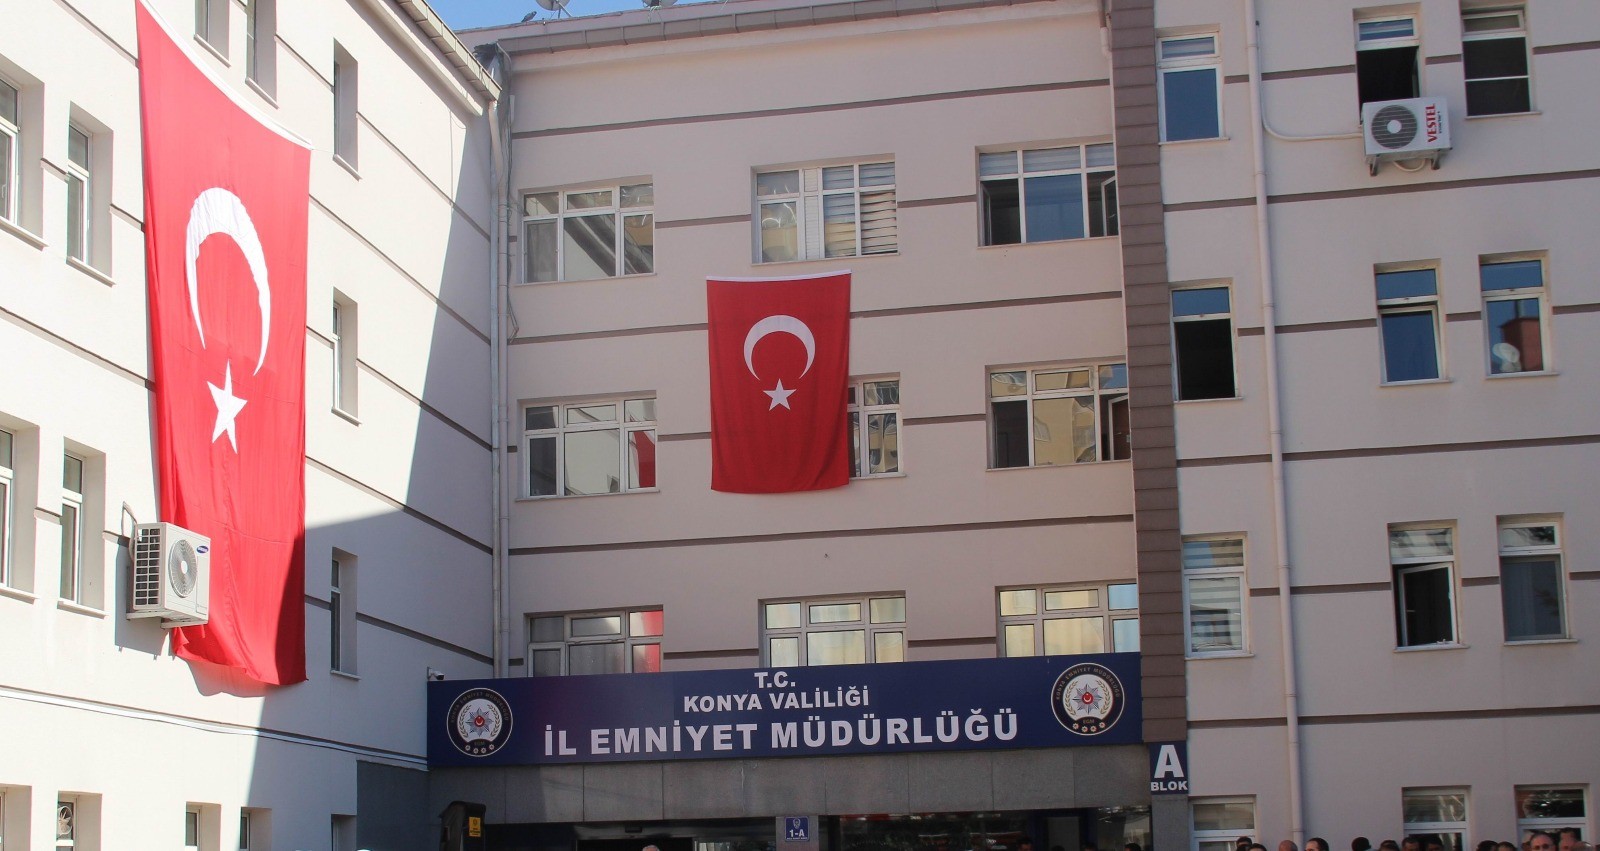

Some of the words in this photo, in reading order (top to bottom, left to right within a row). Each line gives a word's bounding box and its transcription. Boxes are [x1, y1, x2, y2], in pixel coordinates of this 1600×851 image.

[1425, 103, 1438, 143] VESTEL
[753, 671, 796, 689] T.C.
[683, 693, 763, 713] KONYA
[768, 685, 870, 710] VALİLİĞİ
[545, 724, 577, 756] İL
[590, 719, 758, 755] EMNİYET
[771, 708, 1018, 749] MÜDÜRLÜĞÜ
[1154, 744, 1185, 779] A
[1150, 780, 1189, 792] BLOK
[789, 828, 805, 838] 1-A
